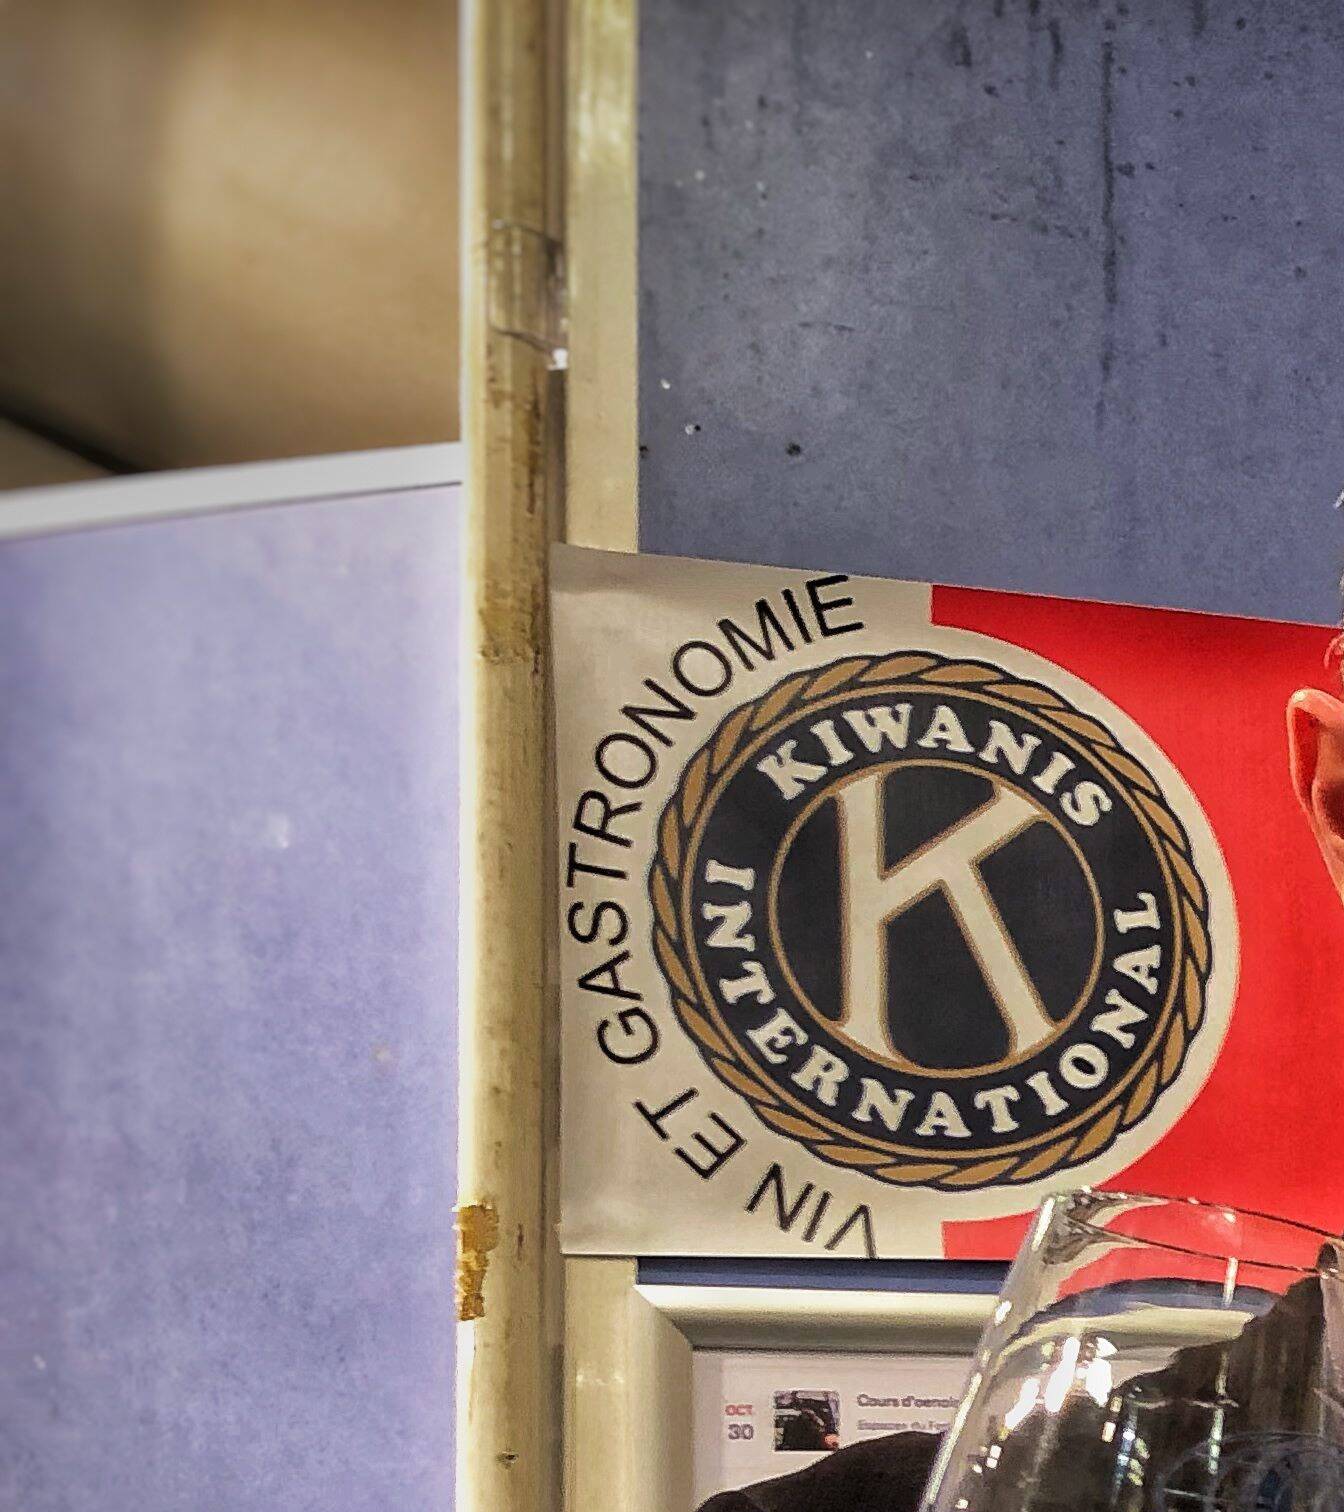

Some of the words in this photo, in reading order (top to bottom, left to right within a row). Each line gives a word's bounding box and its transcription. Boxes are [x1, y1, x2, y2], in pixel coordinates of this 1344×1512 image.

[756, 702, 1113, 829] KIWANIS
[567, 574, 865, 1067] GASTRONOMIE
[835, 770, 1065, 1068] K
[702, 858, 1163, 1139] INTERNATIONAL
[635, 1086, 746, 1180] ET
[745, 1163, 877, 1259] VIN
[725, 1404, 753, 1416] OCT
[728, 1423, 754, 1440] 30
[856, 1393, 900, 1408] Cours
